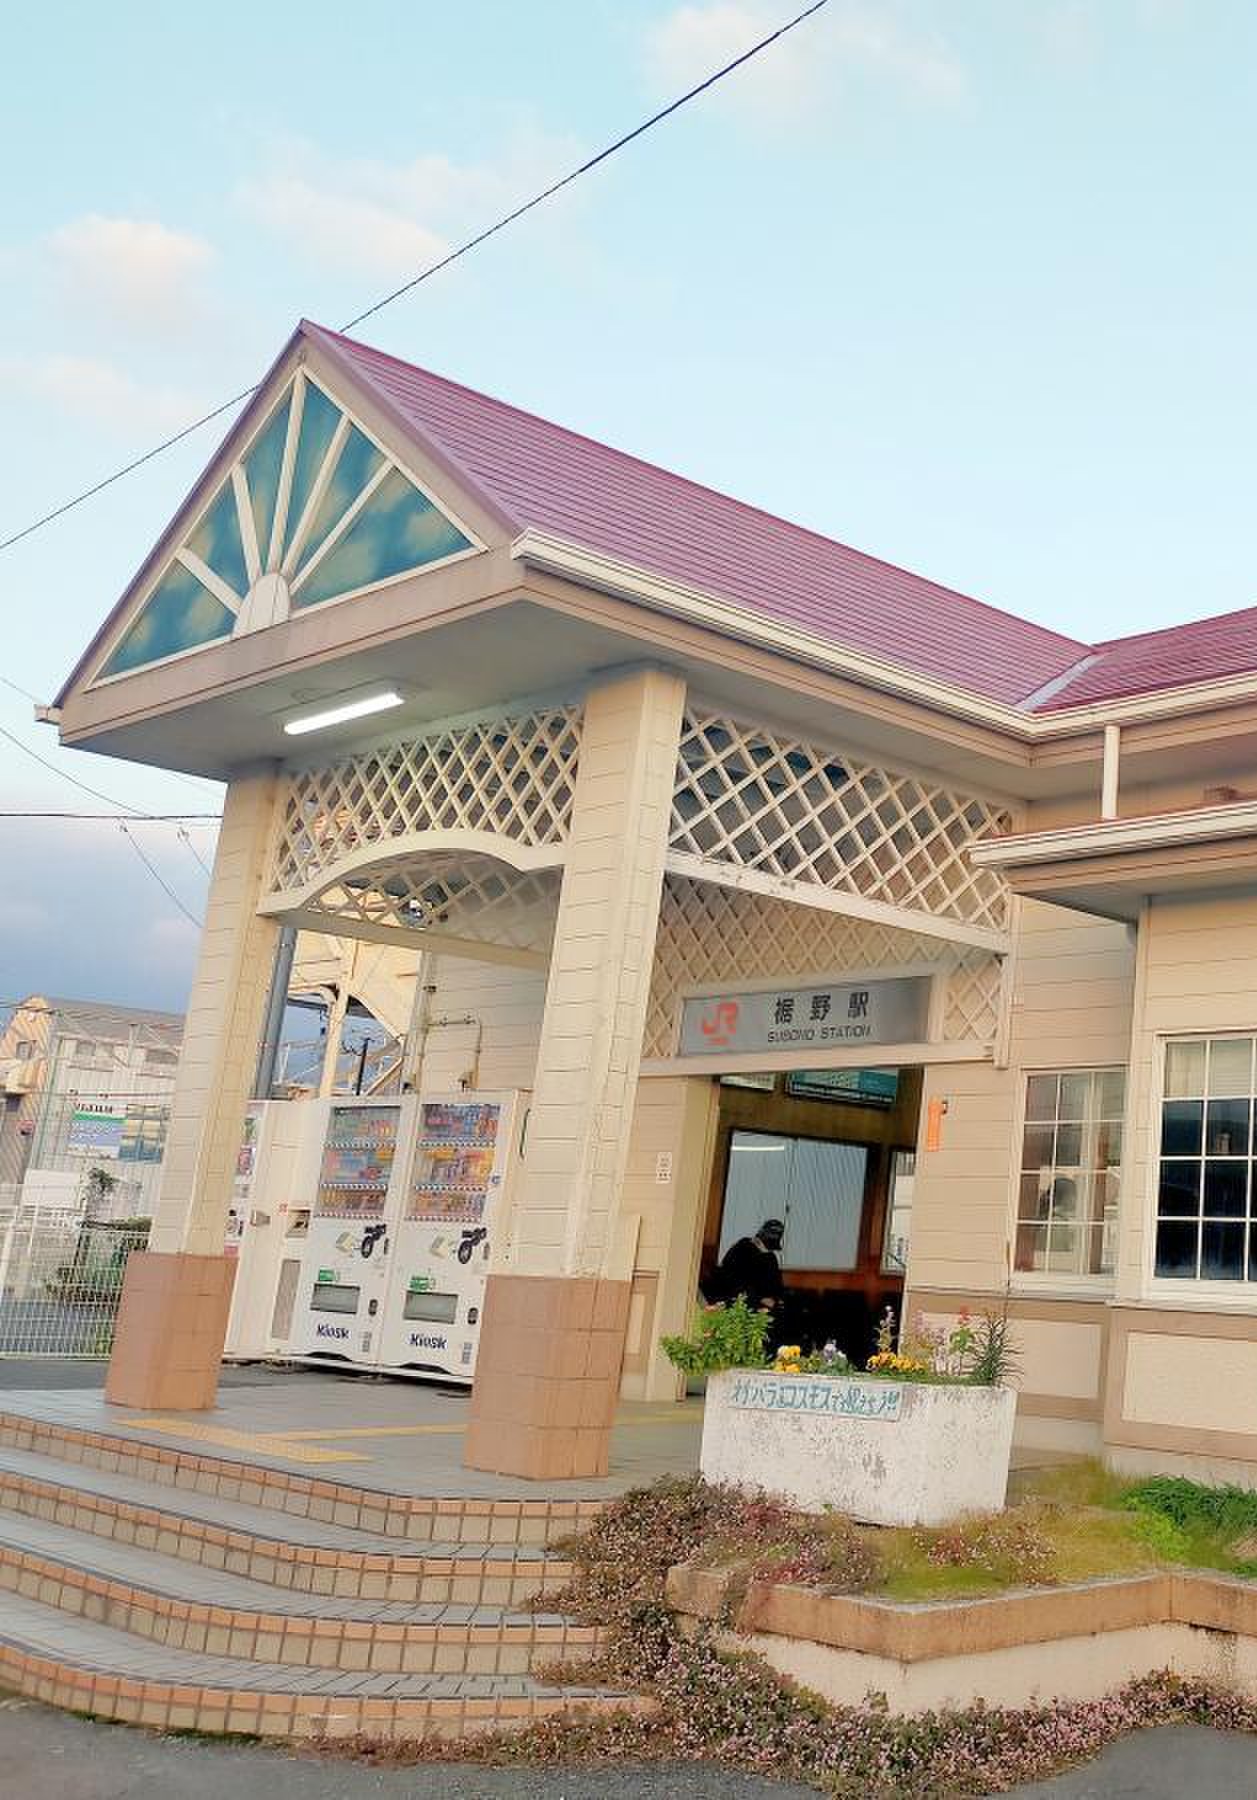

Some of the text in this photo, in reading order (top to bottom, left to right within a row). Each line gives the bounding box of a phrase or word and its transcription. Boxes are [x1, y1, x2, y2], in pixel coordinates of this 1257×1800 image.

[774, 991, 869, 1025] 裾野駅
[702, 1001, 738, 1035] JR
[768, 1024, 873, 1043] SUSONO STATION
[315, 1323, 350, 1340] Kiosk
[409, 1332, 448, 1351] Kiosk
